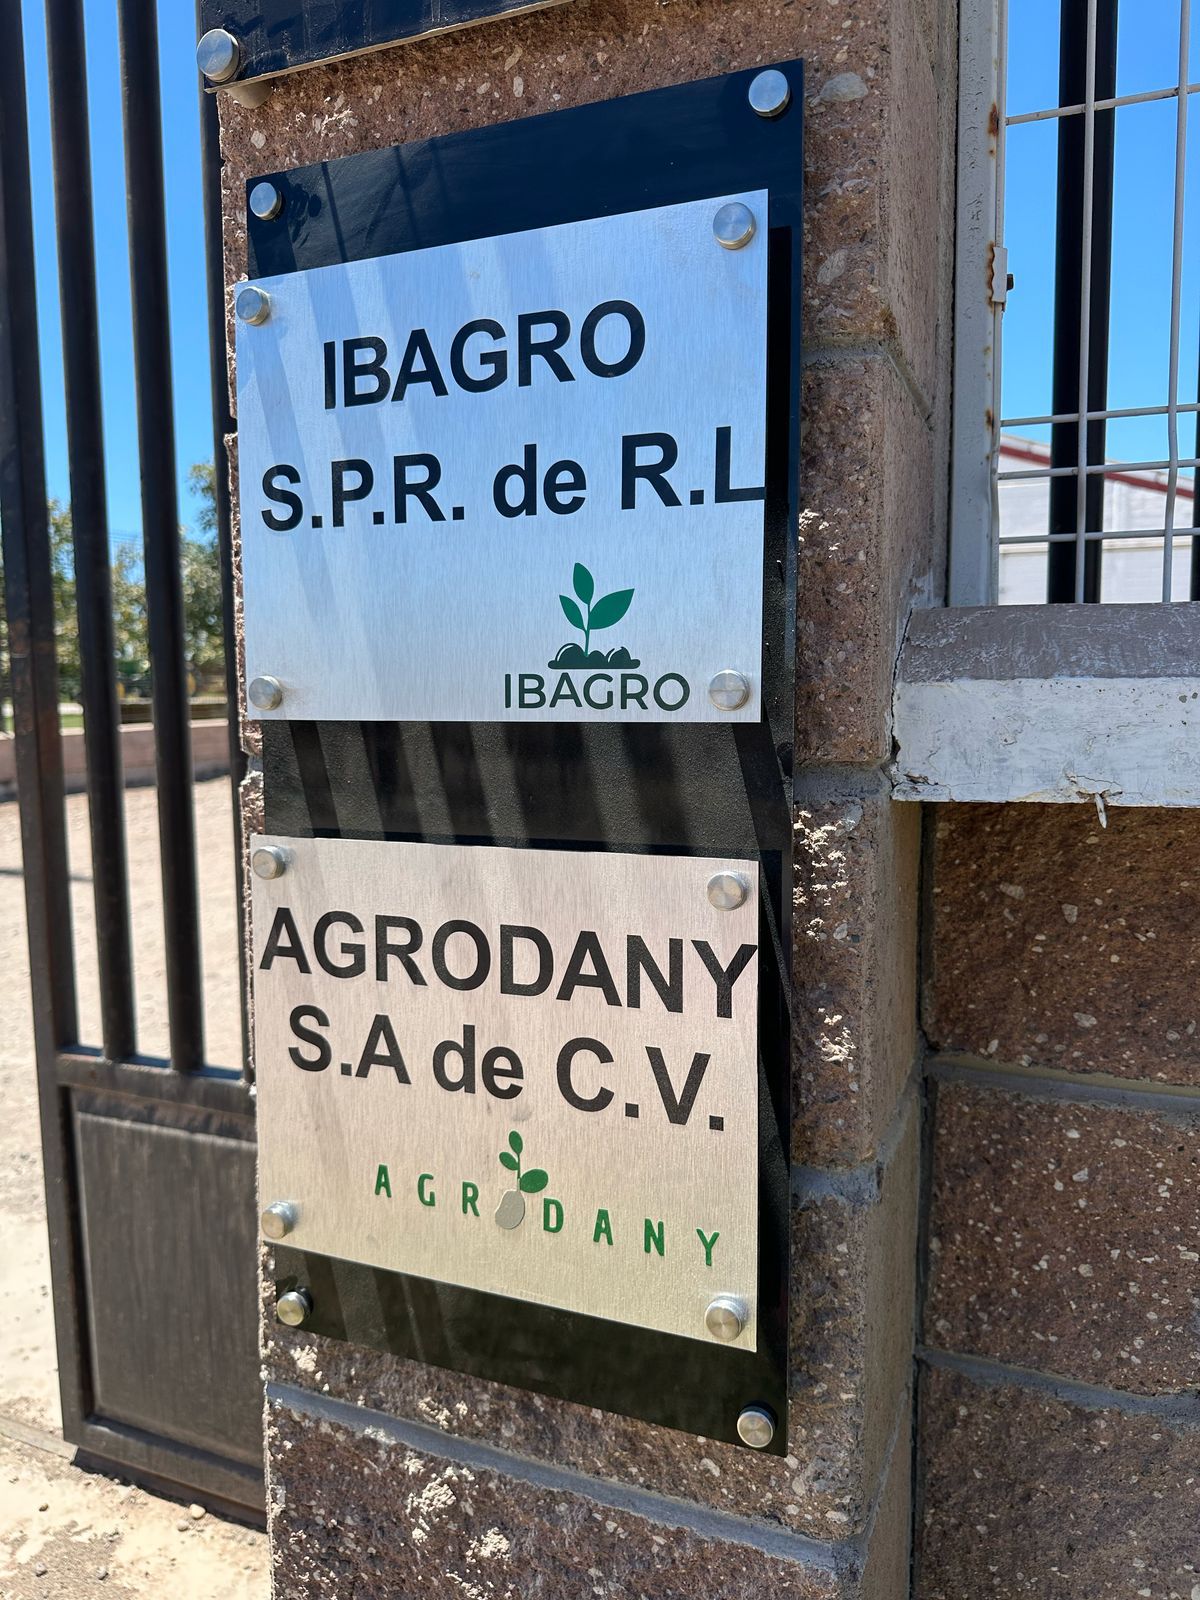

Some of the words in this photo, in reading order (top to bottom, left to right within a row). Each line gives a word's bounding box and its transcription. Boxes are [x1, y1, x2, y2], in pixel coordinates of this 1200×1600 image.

[322, 298, 646, 410] IBAGRO
[261, 453, 464, 532] S.P.R.
[493, 444, 587, 518] de
[621, 426, 766, 510] R.L
[505, 672, 691, 712] IBAGRO
[259, 906, 758, 1019] AGRODANY
[288, 1004, 412, 1084] S.A
[432, 1024, 524, 1100] de
[557, 1037, 724, 1132] C.V.
